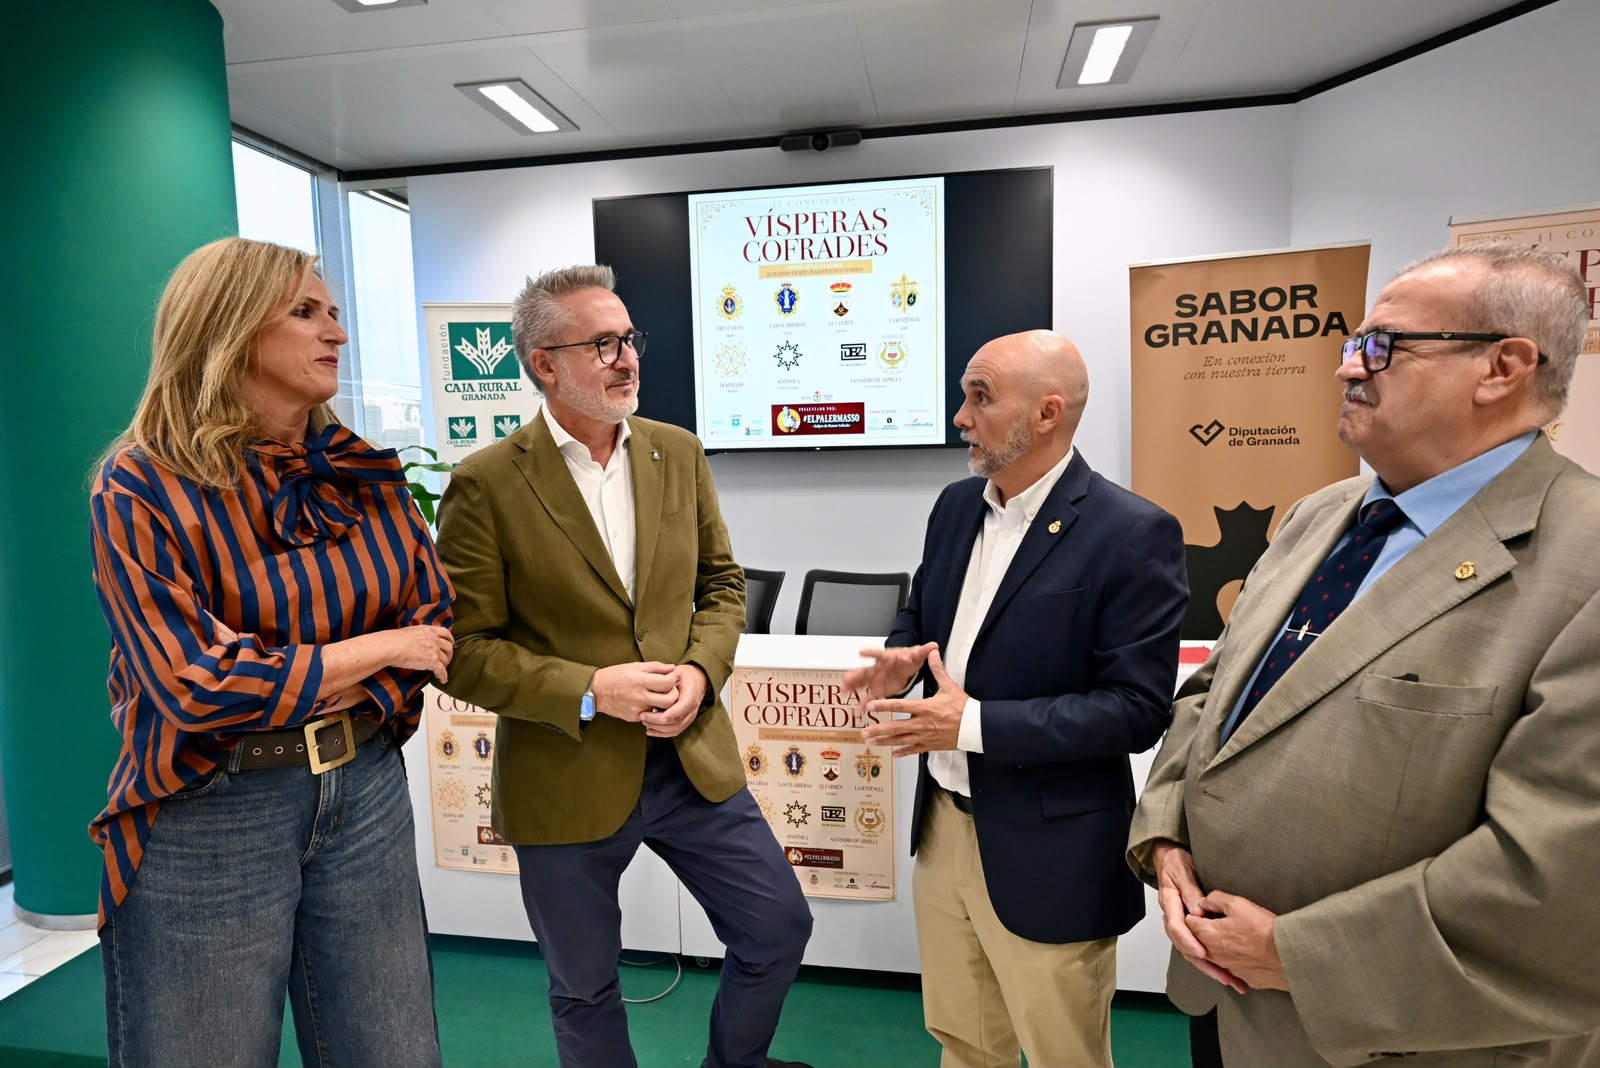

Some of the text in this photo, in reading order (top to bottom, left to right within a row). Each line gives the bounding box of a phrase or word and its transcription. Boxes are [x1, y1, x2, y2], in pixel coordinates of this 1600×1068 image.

[743, 207, 888, 238] VÍSPERAS
[742, 233, 888, 264] COFRADES
[1175, 284, 1318, 318] SABOR
[1144, 312, 1350, 348] GRANADA
[439, 324, 451, 381] fundación
[1203, 356, 1222, 367] En
[1183, 364, 1306, 381] con nuestra tierra
[444, 381, 522, 393] CAJA RURAL
[461, 393, 507, 401] GRANADA
[803, 413, 860, 424] #ELPALERMASSO
[1229, 425, 1296, 438] Diputación
[1229, 436, 1300, 446] de Granada
[745, 677, 878, 706] VÍSPERA
